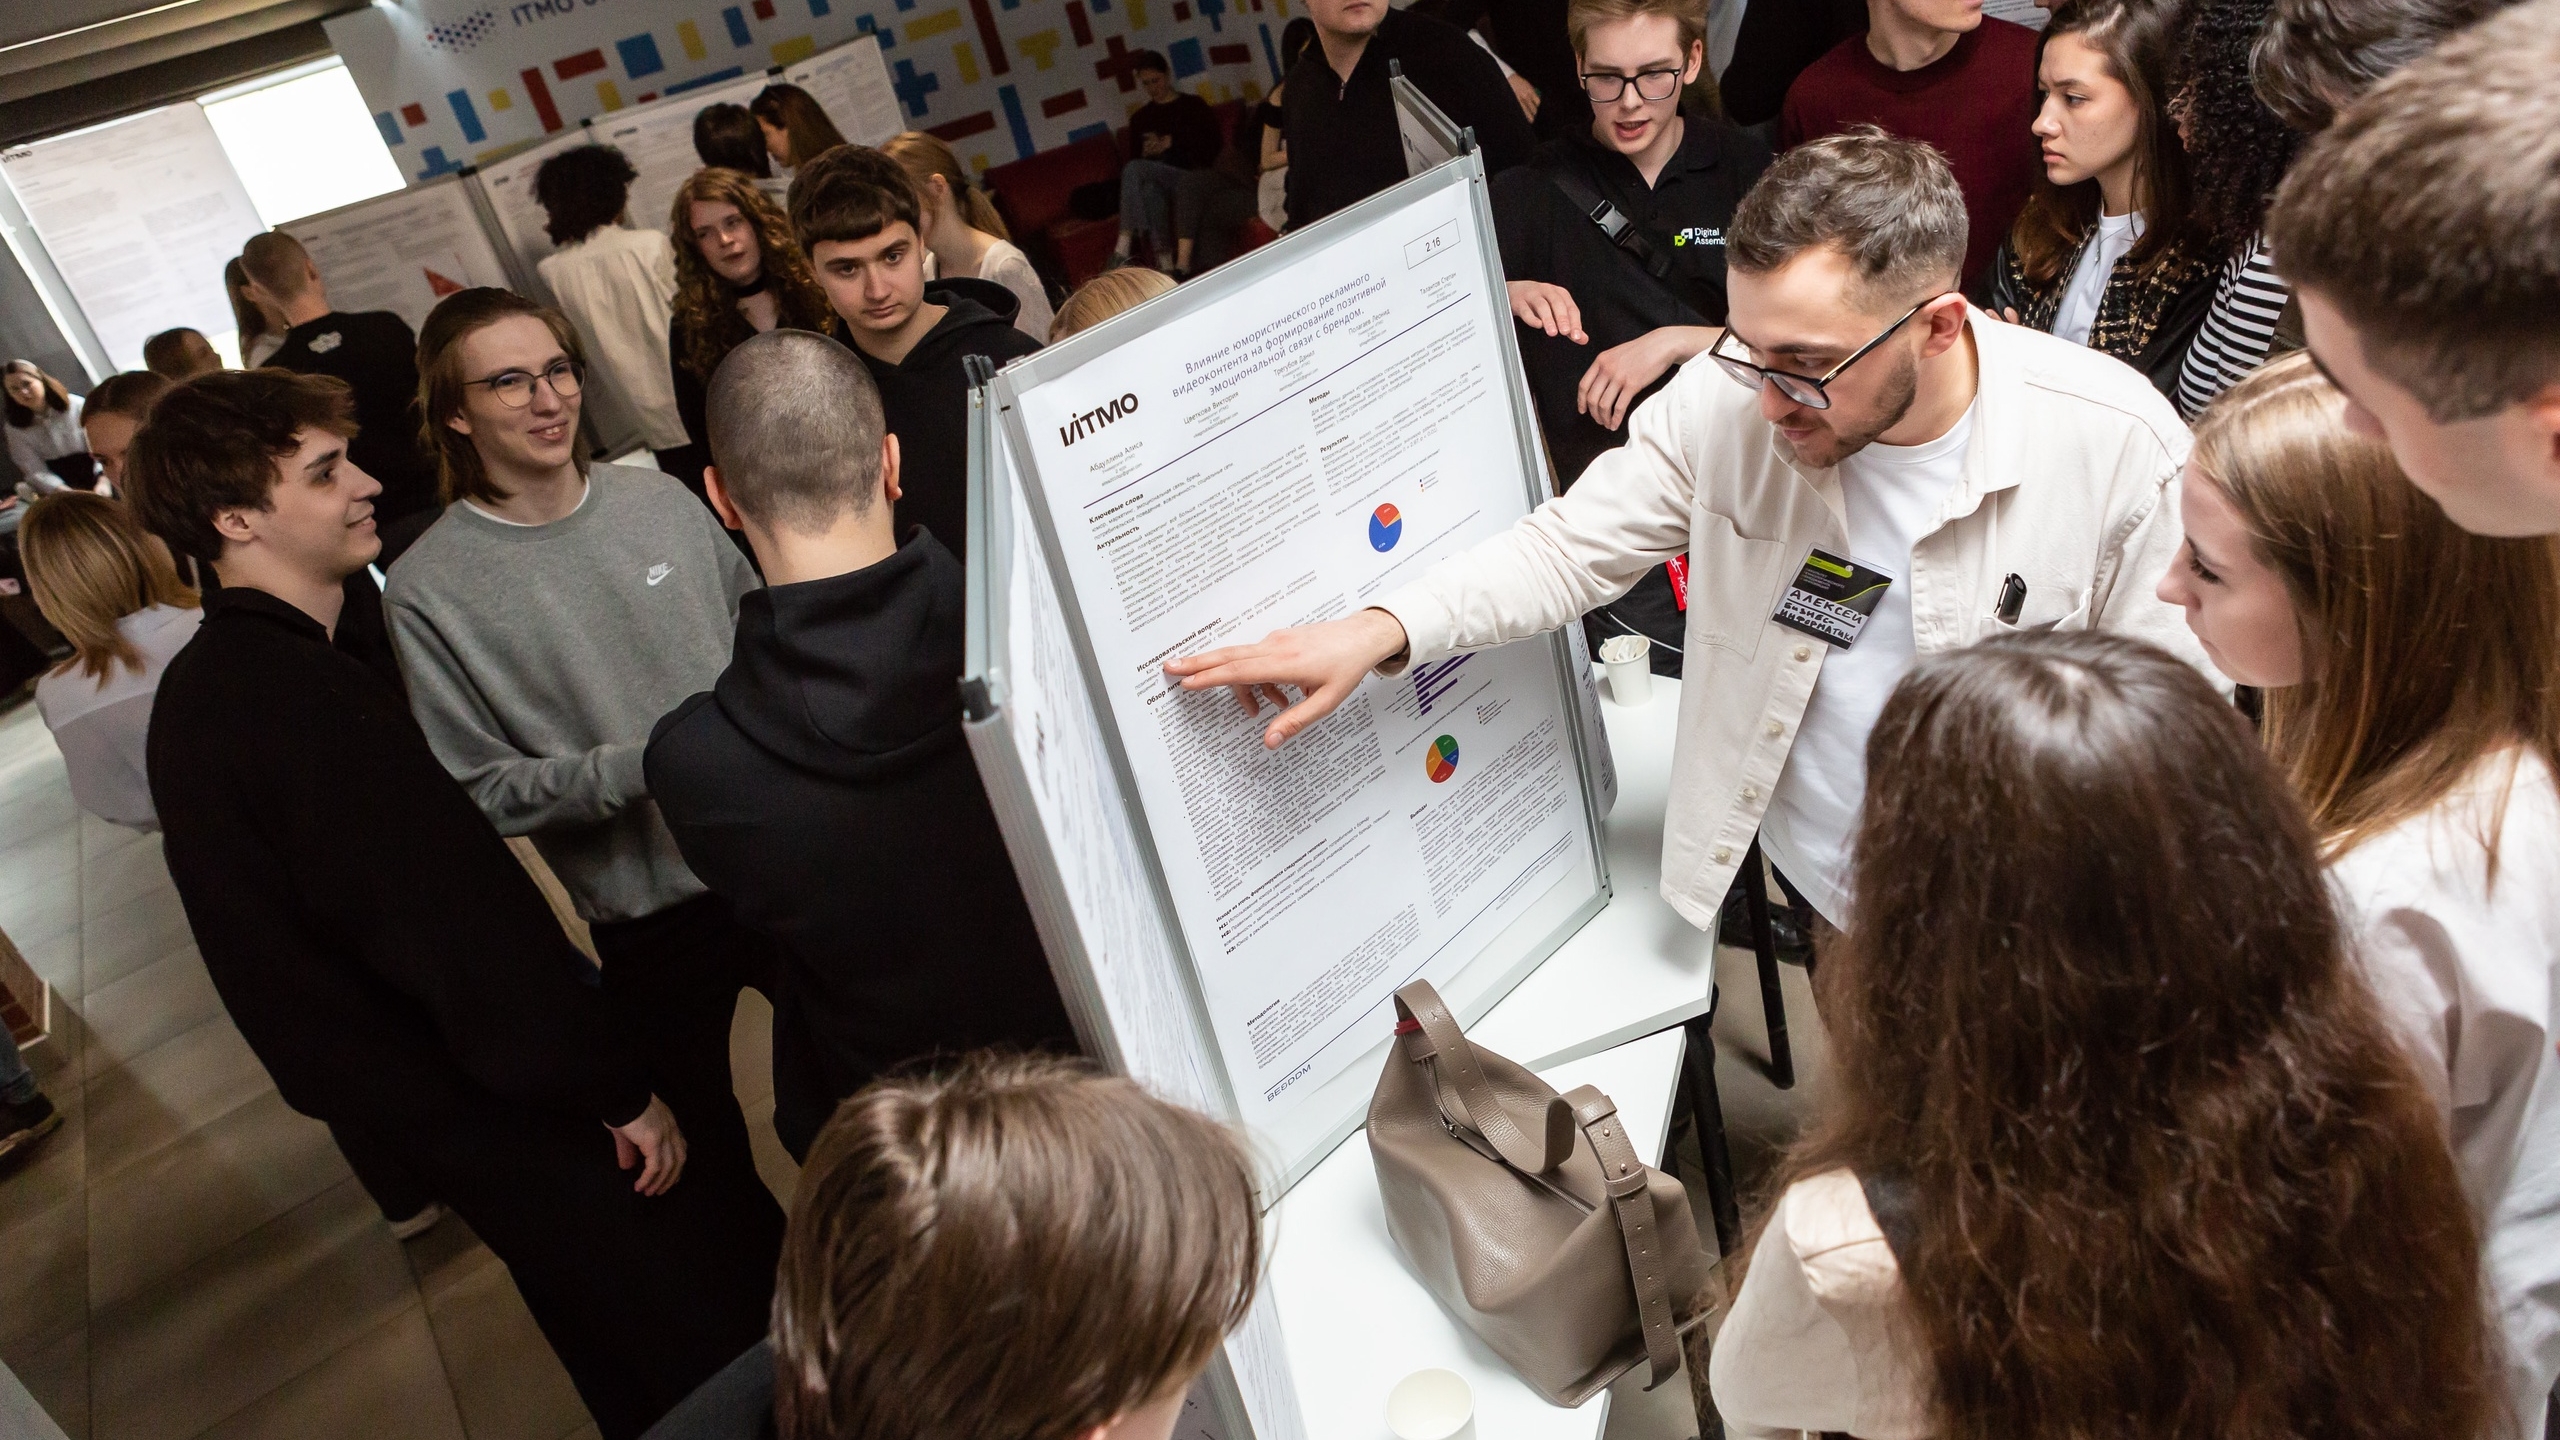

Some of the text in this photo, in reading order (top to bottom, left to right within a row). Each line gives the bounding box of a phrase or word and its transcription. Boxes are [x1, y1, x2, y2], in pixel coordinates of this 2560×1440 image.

[510, 0, 574, 27] ITMO
[1425, 236, 1441, 253] 2.16
[1694, 227, 1720, 238] Digital
[1185, 346, 1230, 375] Влияние
[1232, 301, 1317, 352] юмористического
[1318, 273, 1371, 309] рекламного
[1172, 352, 1249, 398] видеоконтента
[1250, 345, 1263, 358] на
[1265, 307, 1335, 352] формирование
[1336, 279, 1387, 312] позитивной
[1209, 348, 1287, 397] эмоциональной
[1288, 333, 1314, 354] связи
[1315, 329, 1322, 339] с
[1322, 307, 1365, 335] брендом.
[1308, 389, 1331, 405] Методы
[1319, 434, 1349, 454] Результаты
[1088, 493, 1144, 525] Ключевые слова
[1096, 526, 1140, 551] Актуальность
[648, 562, 669, 578] NIKE
[1790, 589, 1863, 624] АЛЕКСЕЙ
[1136, 617, 1222, 673] Исследовательский вопрос:
[1146, 678, 1183, 706] Обзор лите
[1409, 803, 1428, 820] Выводы
[1246, 998, 1281, 1028] Методология
